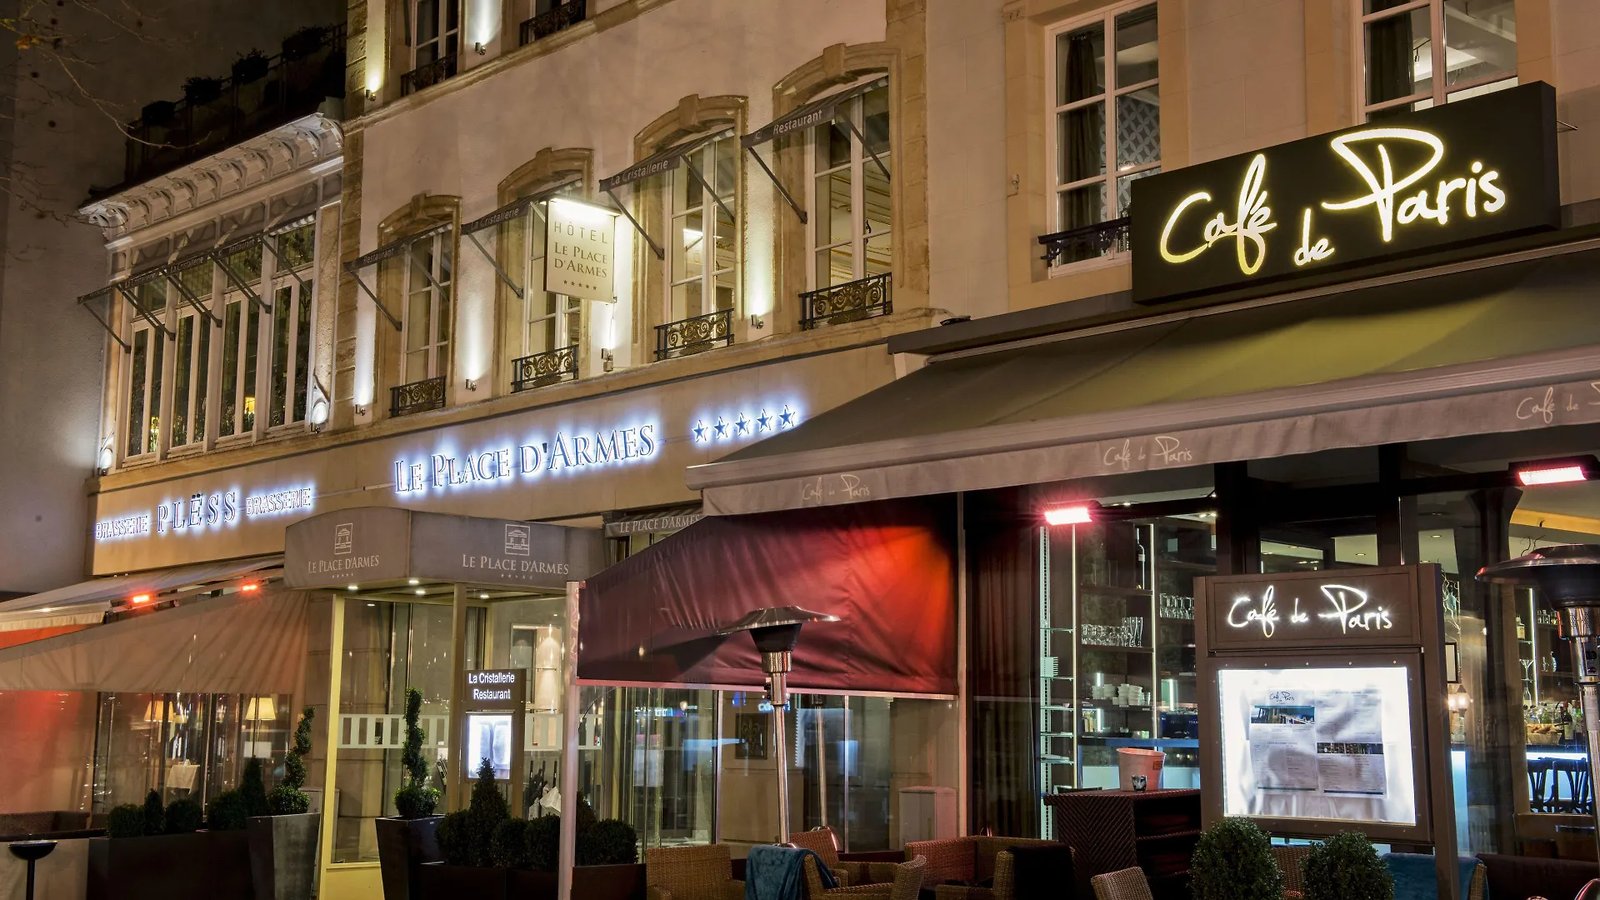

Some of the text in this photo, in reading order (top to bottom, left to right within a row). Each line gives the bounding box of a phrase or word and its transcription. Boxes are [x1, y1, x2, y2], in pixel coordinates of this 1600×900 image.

[772, 109, 823, 136] Restaurant
[622, 159, 669, 182] Cristallerie
[1160, 127, 1506, 275] Café de Paris
[554, 221, 608, 245] HÔTEL
[573, 246, 608, 264] PLACE
[554, 258, 608, 279] D'ARMES
[1567, 394, 1579, 412] de
[395, 423, 656, 493] LE PLACE D'ARMES
[1152, 436, 1193, 465] Paris
[840, 473, 871, 499] Paris
[95, 487, 312, 540] BRASSERIE PLËSS BRASSERIE
[620, 521, 630, 533] LE
[632, 517, 659, 532] PLACE
[319, 558, 343, 573] PLACE
[345, 554, 380, 570] D'ARMES
[480, 555, 517, 571] PLACE
[521, 560, 569, 575] D'ARMES
[1227, 584, 1393, 638] Café de Paris
[468, 672, 515, 684] La Cristallerie
[473, 688, 511, 700] Restaurant
